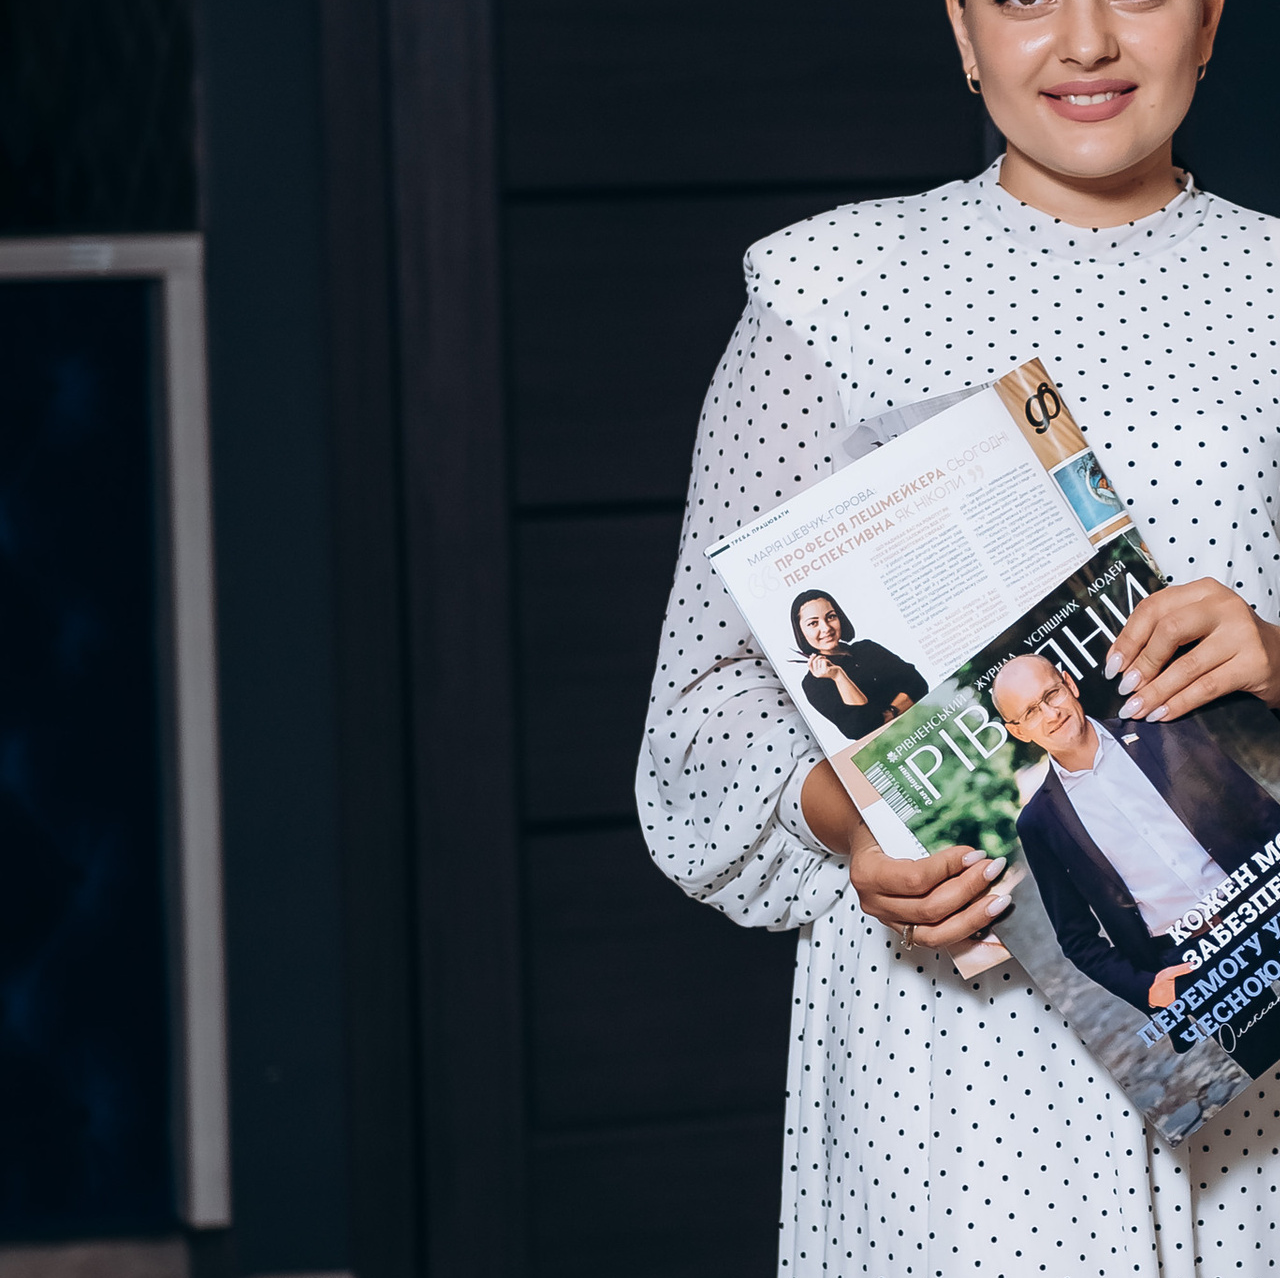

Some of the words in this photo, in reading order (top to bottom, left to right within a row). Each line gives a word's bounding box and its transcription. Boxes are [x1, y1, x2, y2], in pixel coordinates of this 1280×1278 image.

[730, 531, 750, 546] ТРЕБА
[750, 508, 790, 534] ПРАЦЮВАТИ
[746, 539, 784, 566] МАРІЯ
[781, 485, 878, 546] ШЕВЧУК-ГОРОВА:
[773, 521, 848, 572] ПРОФЕСІЯ
[848, 465, 946, 528] ЛЕШМЕЙКЕРА
[945, 431, 1009, 472] СЬОГОДНІ
[783, 515, 895, 588] ПЕРСПЕКТИВНА
[894, 504, 915, 522] ЯК
[913, 474, 966, 511] НІКОЛИ
[894, 691, 967, 756] РІВНЕНСЬКИЙ
[1023, 598, 1080, 648] УСПІШНИХ
[1085, 558, 1126, 597] ЛЮДЕЙ
[903, 571, 1149, 800] РІВЯНИ
[1165, 861, 1259, 946] КОЖЕН
[1137, 931, 1260, 1046] ПЕРЕМОГУ
